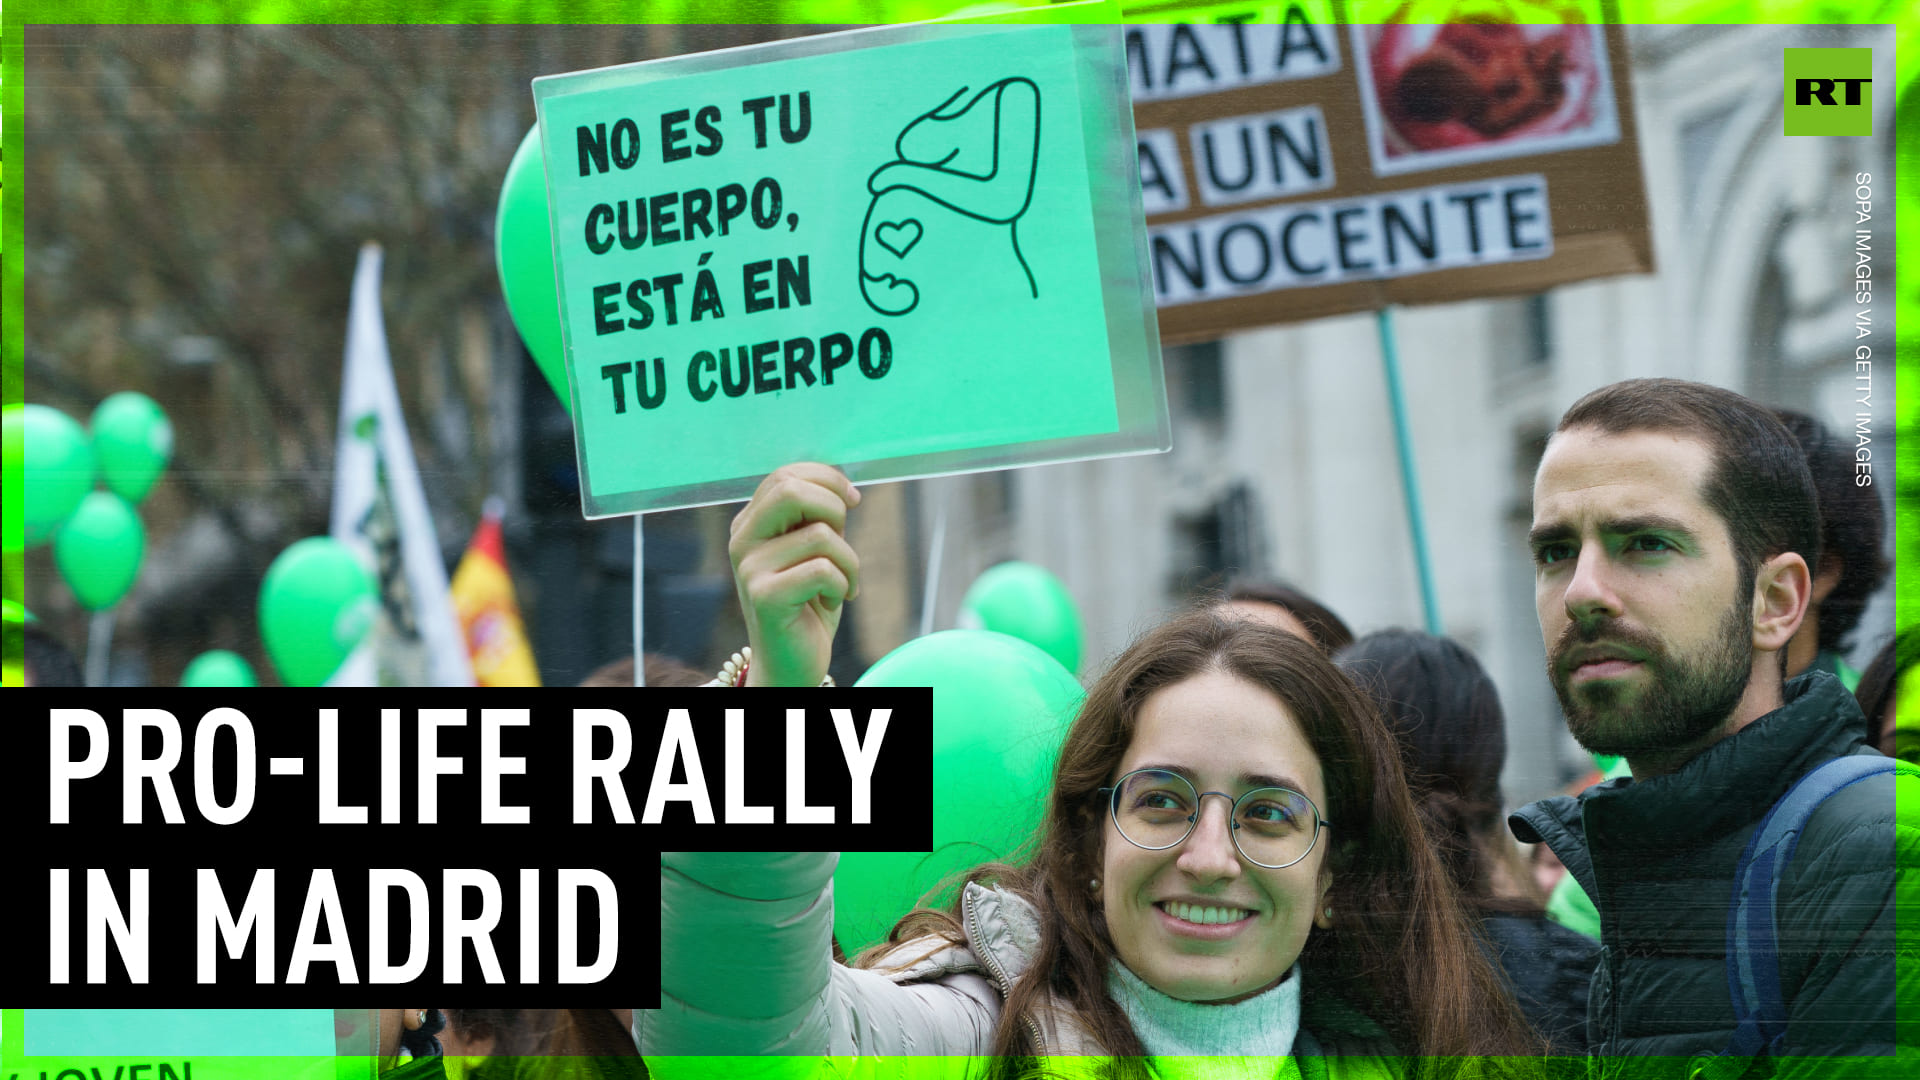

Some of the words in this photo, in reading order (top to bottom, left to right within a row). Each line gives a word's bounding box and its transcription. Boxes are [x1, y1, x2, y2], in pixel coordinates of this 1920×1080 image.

[576, 118, 641, 177] NO
[660, 105, 724, 163] ES
[742, 91, 812, 149] TU
[1201, 116, 1323, 193] UN
[584, 177, 799, 255] CUERPO,
[1151, 186, 1546, 295] NOCENTE
[592, 251, 725, 337] ESTÁ
[742, 254, 812, 314] EN
[601, 357, 667, 414] TU
[686, 327, 893, 403] CUERPO
